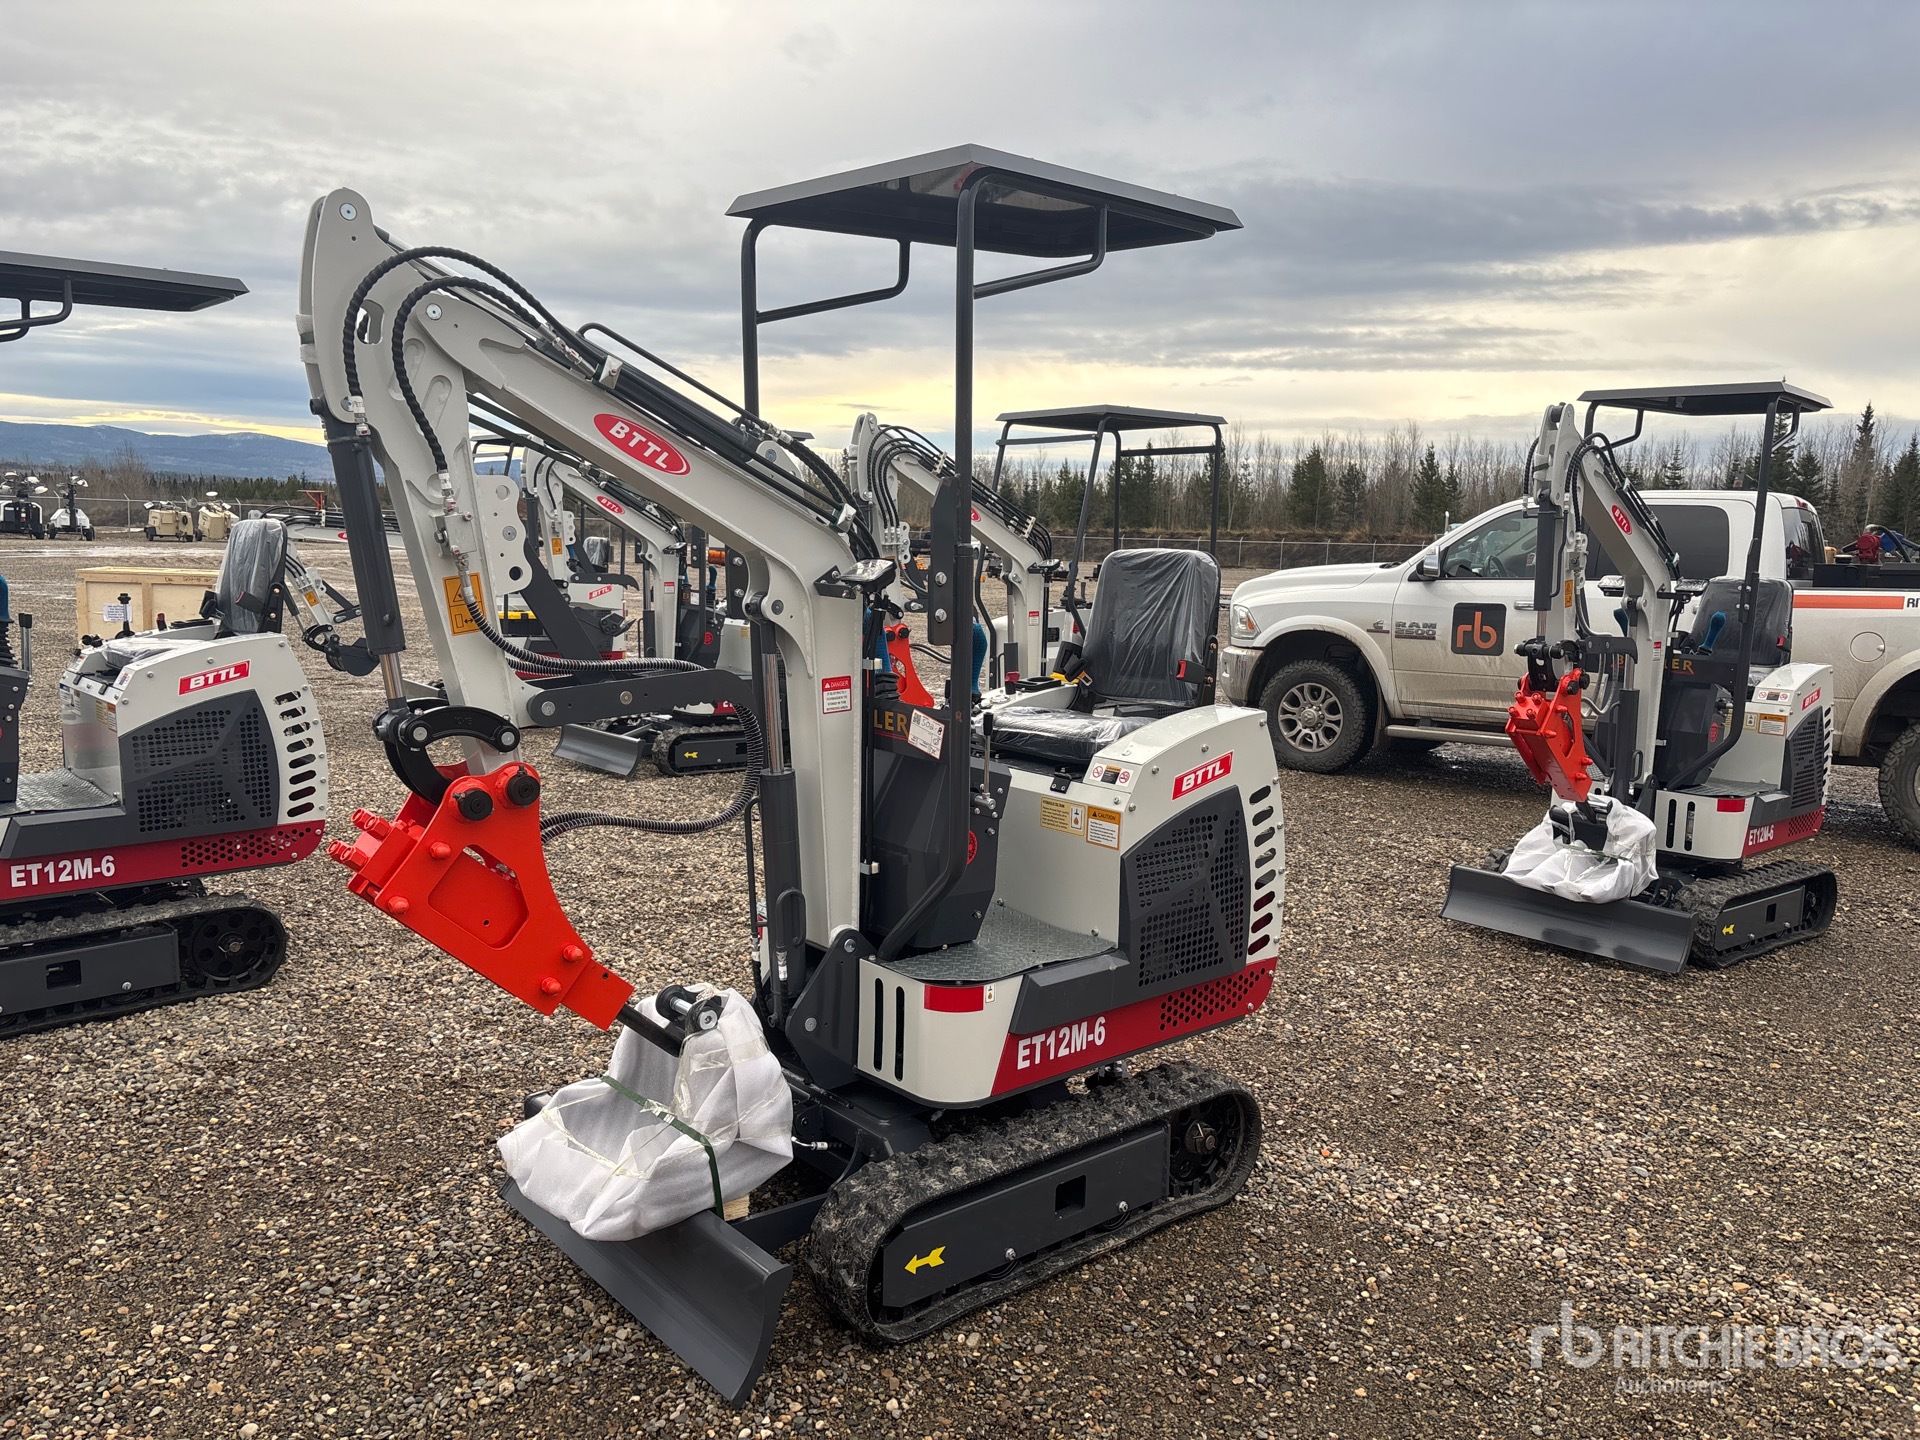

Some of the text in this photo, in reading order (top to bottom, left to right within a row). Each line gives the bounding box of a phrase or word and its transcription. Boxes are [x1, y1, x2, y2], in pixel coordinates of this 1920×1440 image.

[609, 420, 669, 469] BTTL
[602, 498, 619, 513] BTTL
[1614, 508, 1628, 532] BTTL
[592, 585, 609, 597] BTTL
[1395, 621, 1437, 629] RAM
[1395, 628, 1436, 636] 2500
[1456, 611, 1498, 649] rb
[190, 667, 241, 690] BTTL
[1181, 760, 1225, 792] BTTL
[1097, 812, 1116, 822] CAUTION
[1748, 824, 1775, 846] ET12M-6
[10, 855, 116, 888] ET12M-6
[1017, 1016, 1106, 1070] ET12M-6
